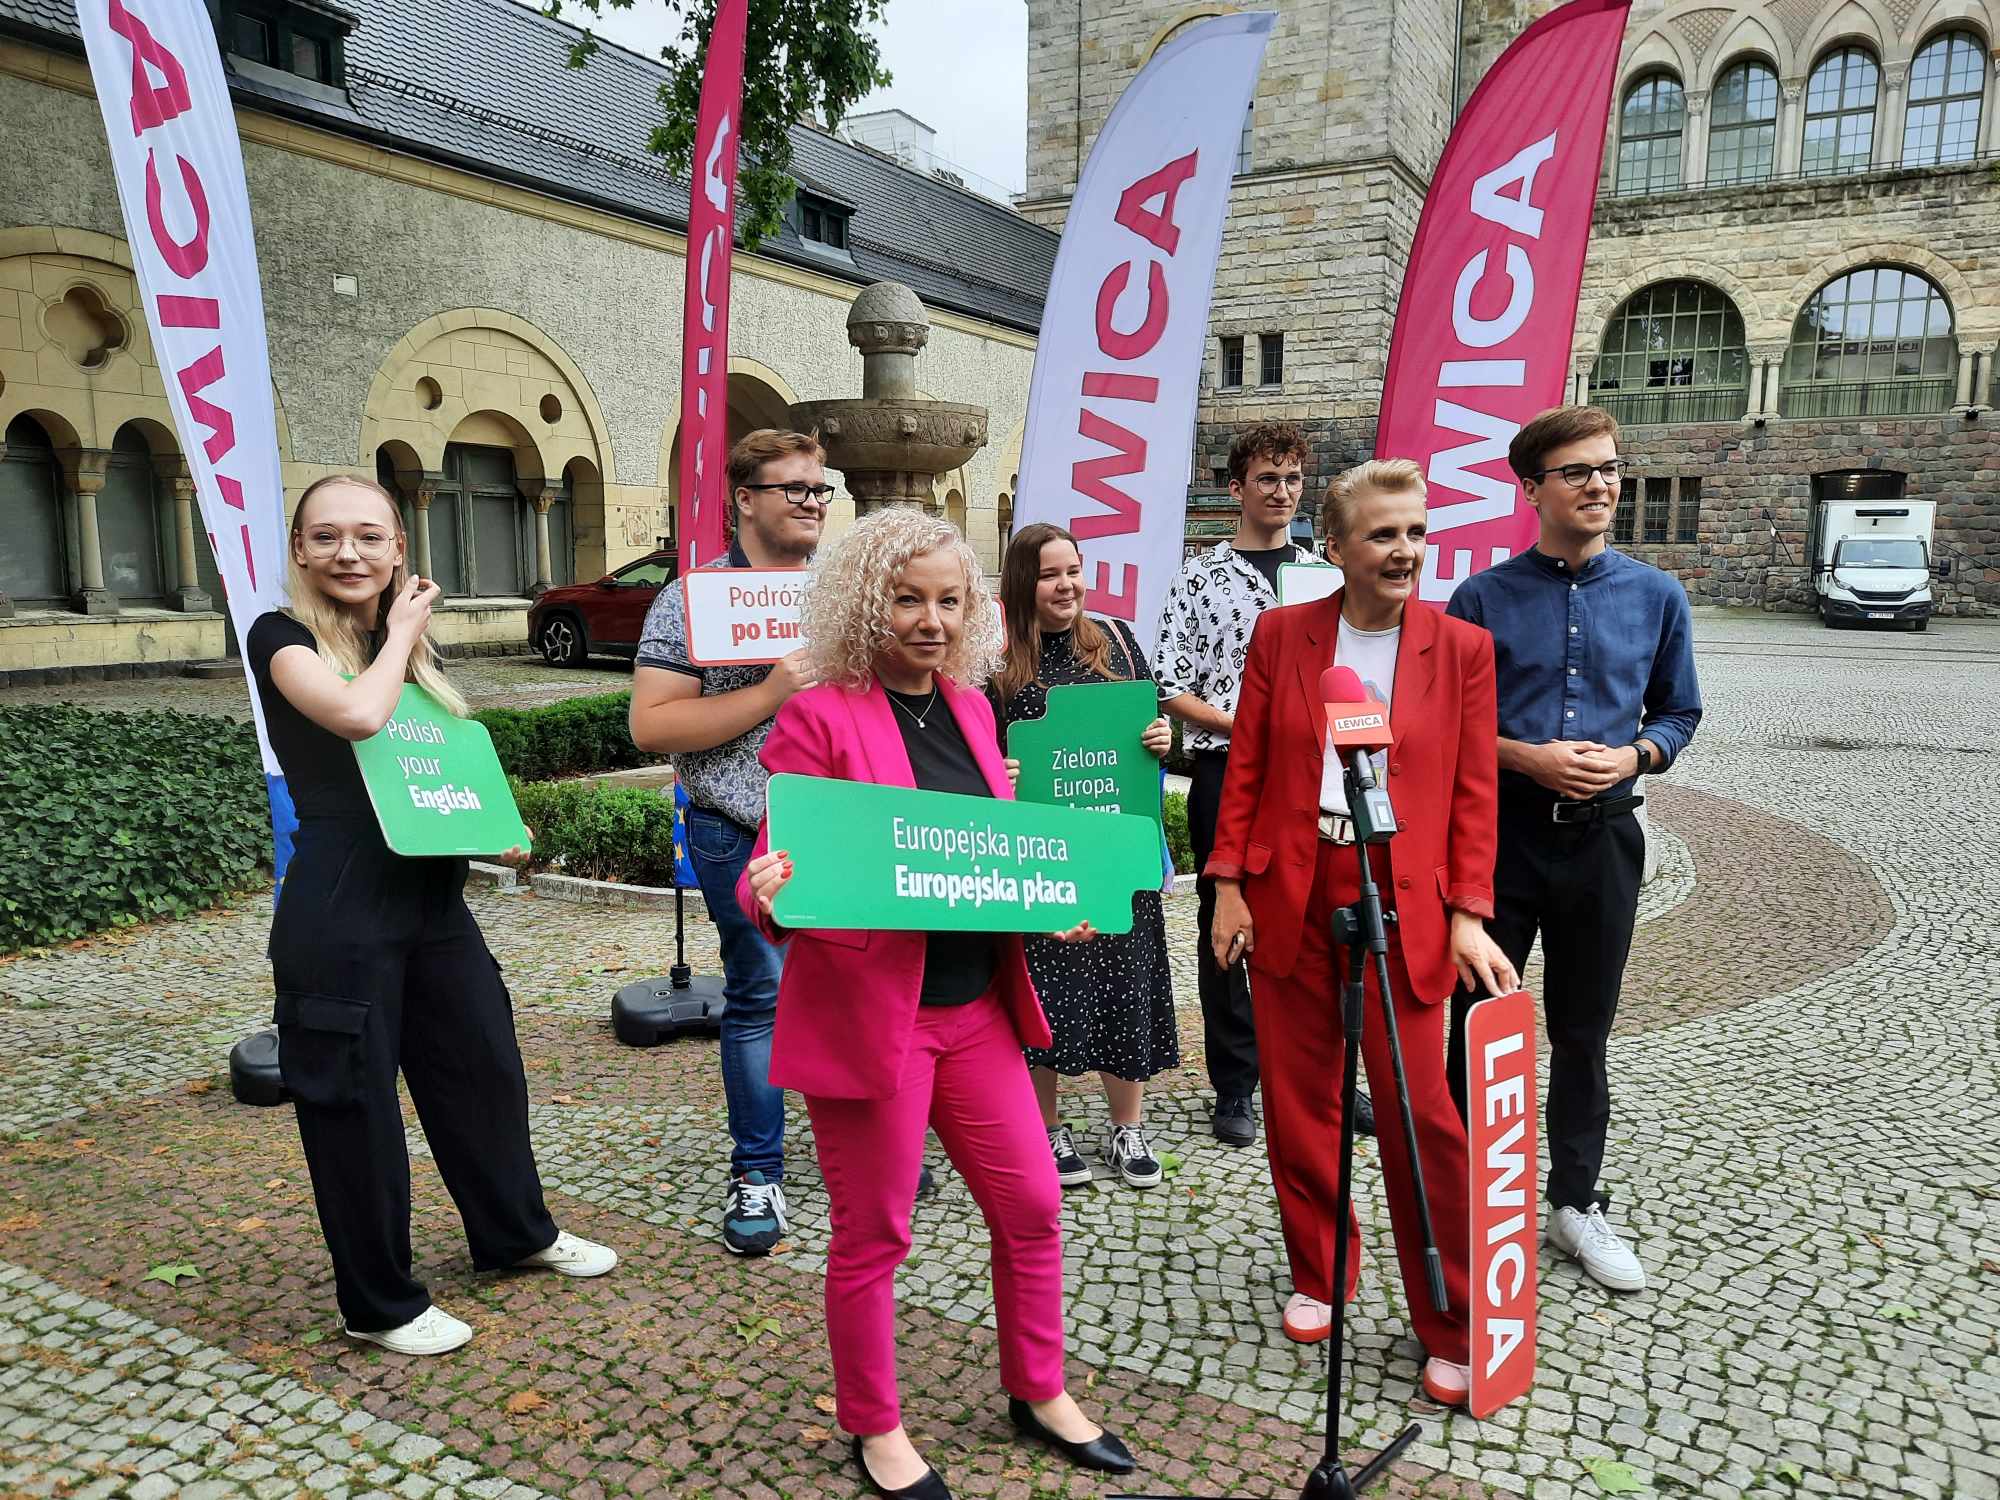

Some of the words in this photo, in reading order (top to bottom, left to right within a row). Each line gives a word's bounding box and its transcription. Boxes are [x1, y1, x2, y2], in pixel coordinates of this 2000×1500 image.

[1418, 128, 1558, 601] EWICA
[1070, 147, 1198, 622] EWICA
[729, 582, 806, 607] Podróż
[732, 622, 761, 646] po
[765, 618, 801, 639] Eur
[386, 718, 448, 745] Polish
[1337, 716, 1381, 730] LEWICA
[396, 755, 442, 780] your
[1052, 747, 1118, 770] Zielona
[408, 784, 482, 815] English
[1054, 777, 1120, 799] Europa,
[893, 817, 1010, 862] Europejska
[1017, 835, 1068, 865] praca
[895, 864, 1019, 908] Europejska
[1023, 872, 1077, 910] płaca
[1484, 1032, 1526, 1380] LEWICA
